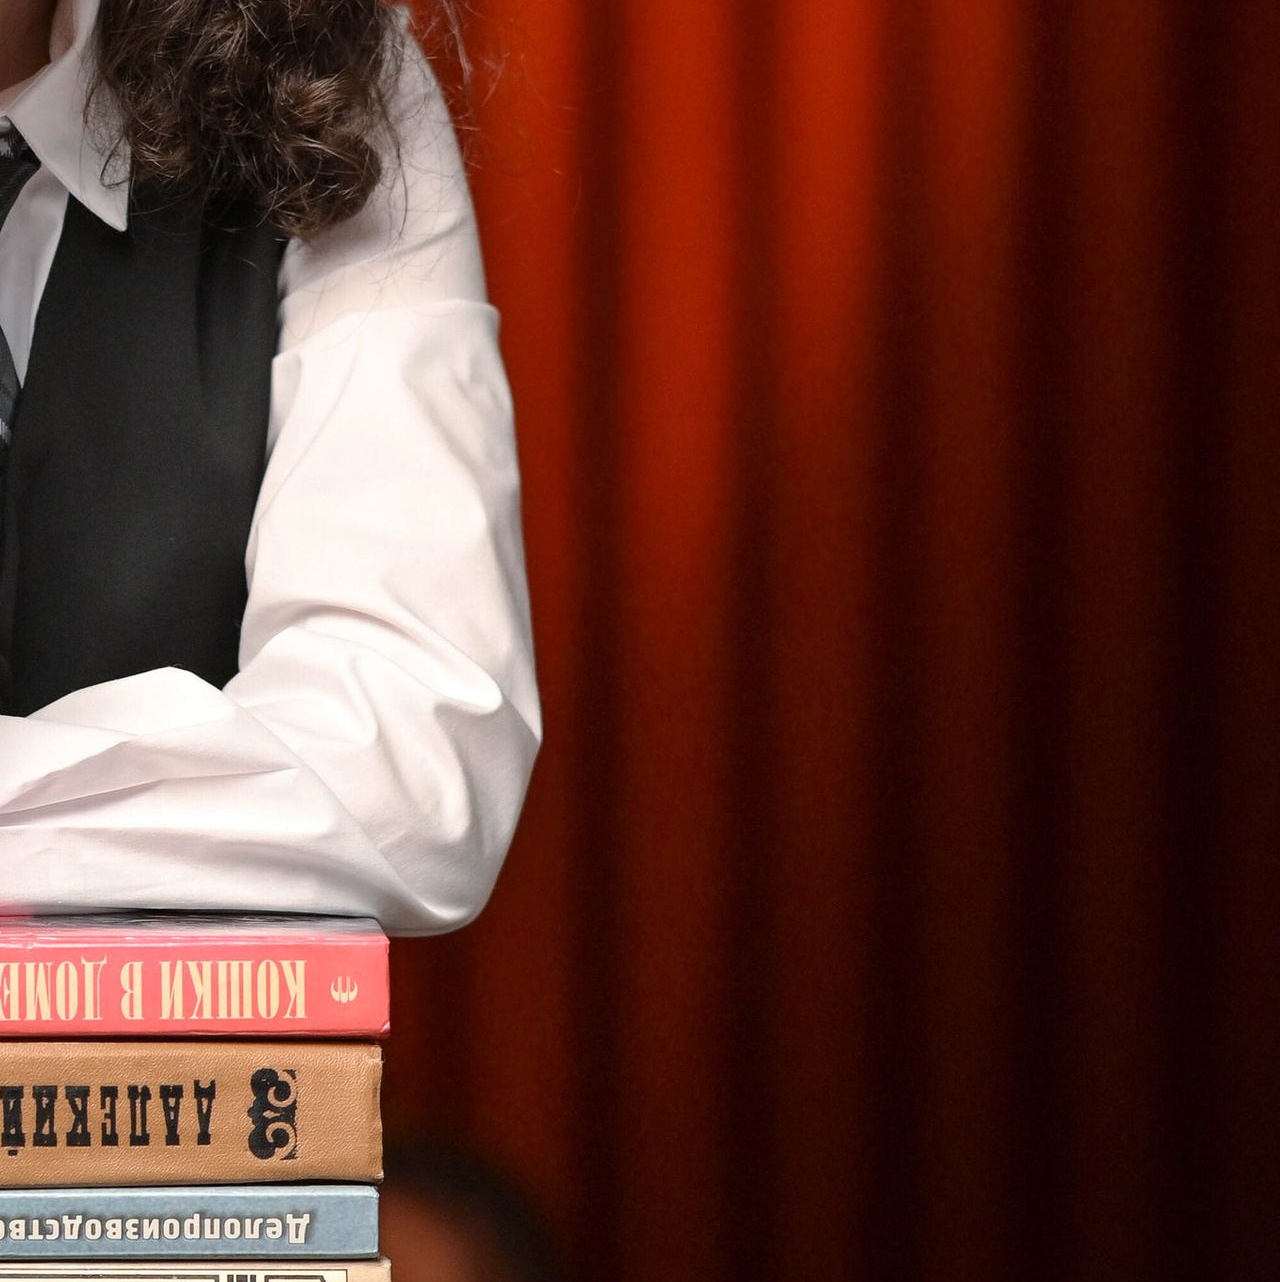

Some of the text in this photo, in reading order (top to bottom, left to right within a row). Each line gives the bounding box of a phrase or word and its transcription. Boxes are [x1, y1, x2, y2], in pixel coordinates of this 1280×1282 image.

[120, 961, 144, 1021] В
[160, 959, 308, 1020] КОШКИ
[0, 1079, 217, 1157] ДАЛЕКИЙ
